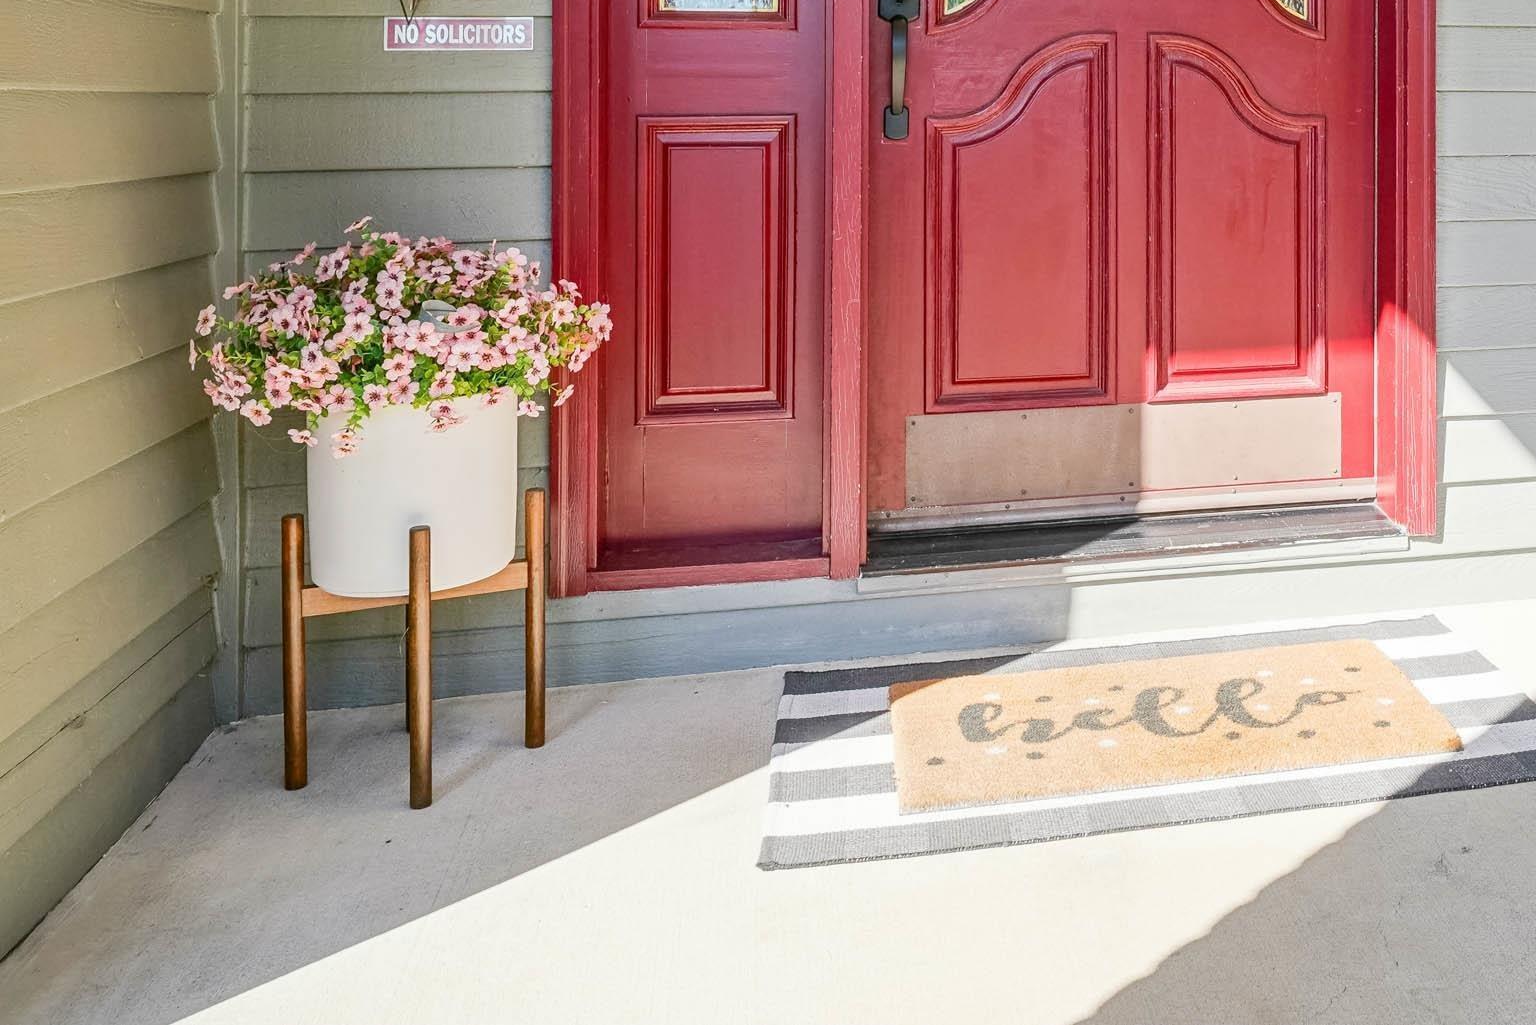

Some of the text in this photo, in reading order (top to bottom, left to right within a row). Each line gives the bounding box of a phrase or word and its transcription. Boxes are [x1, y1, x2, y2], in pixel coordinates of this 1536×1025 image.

[394, 24, 526, 44] NO SOLICITORS
[957, 677, 1361, 743] hello
